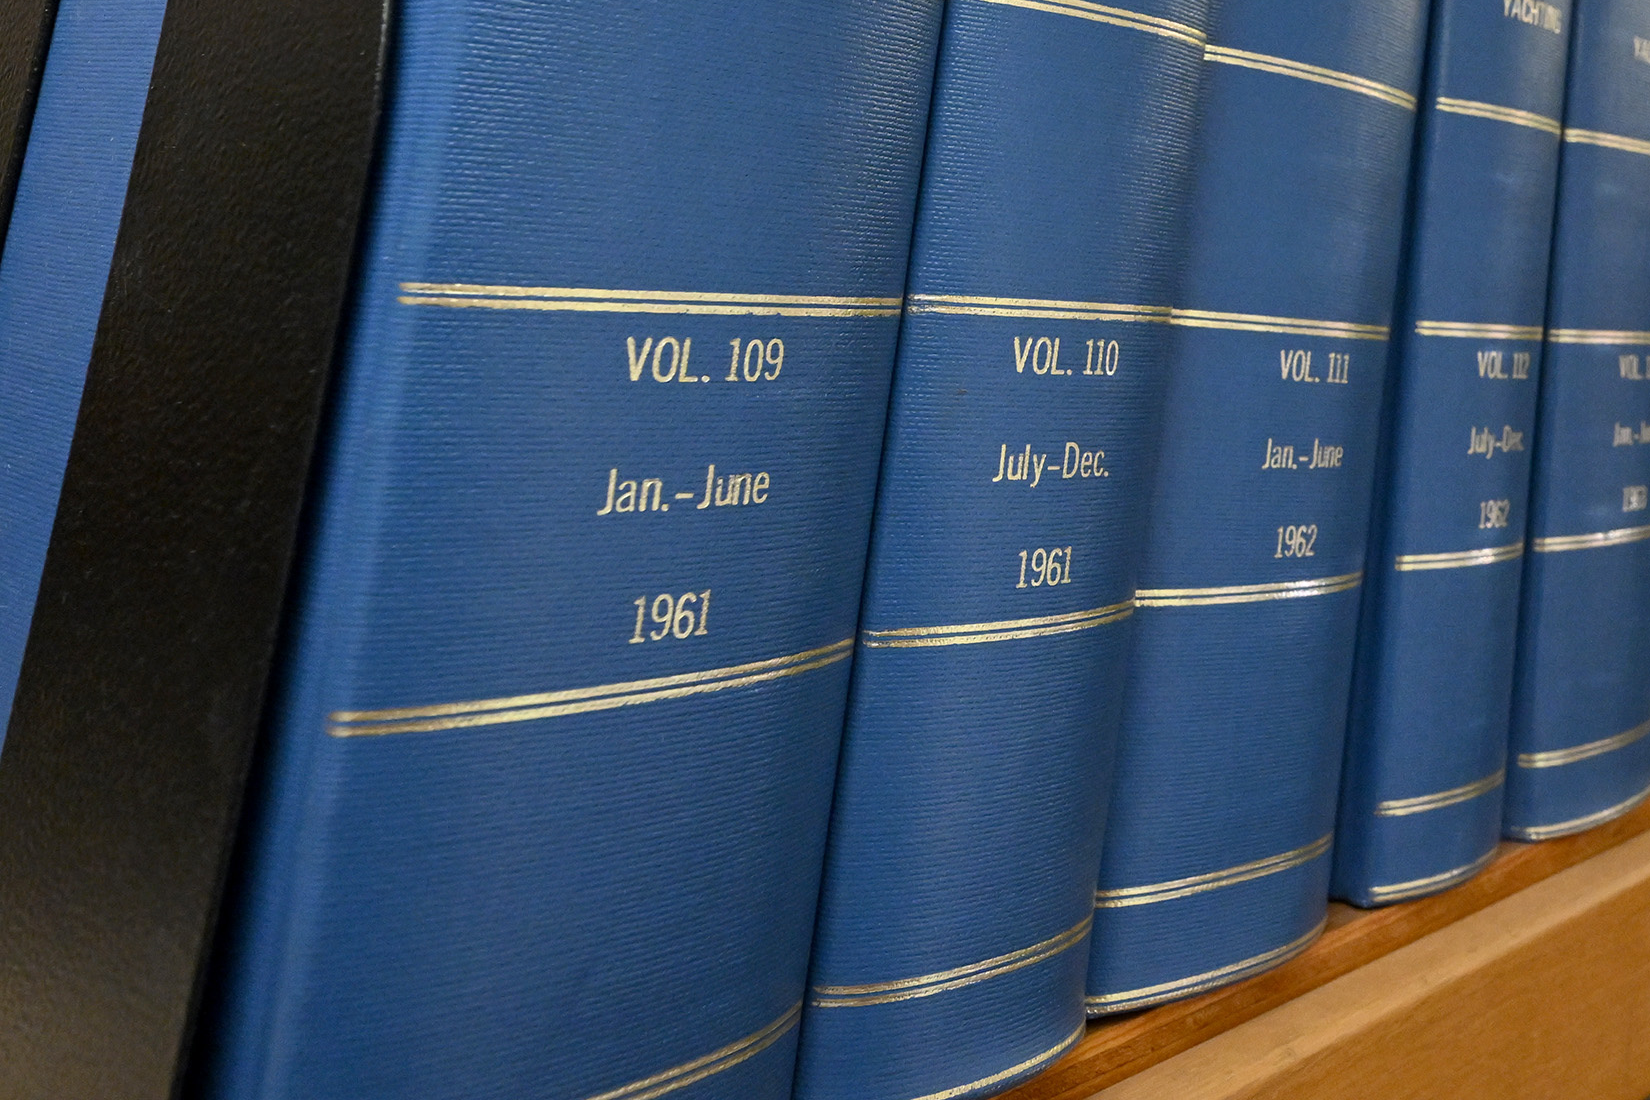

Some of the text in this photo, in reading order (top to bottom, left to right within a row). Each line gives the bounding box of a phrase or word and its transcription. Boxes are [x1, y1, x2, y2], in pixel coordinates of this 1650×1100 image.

[626, 336, 785, 383] VOL. 109
[1013, 336, 1120, 376] VOL. 110
[1280, 350, 1350, 384] VOL. 111
[992, 441, 1109, 488] July-Dec.
[1274, 524, 1318, 559] 1962
[1016, 545, 1072, 589] 1961
[629, 590, 711, 645] 1961
